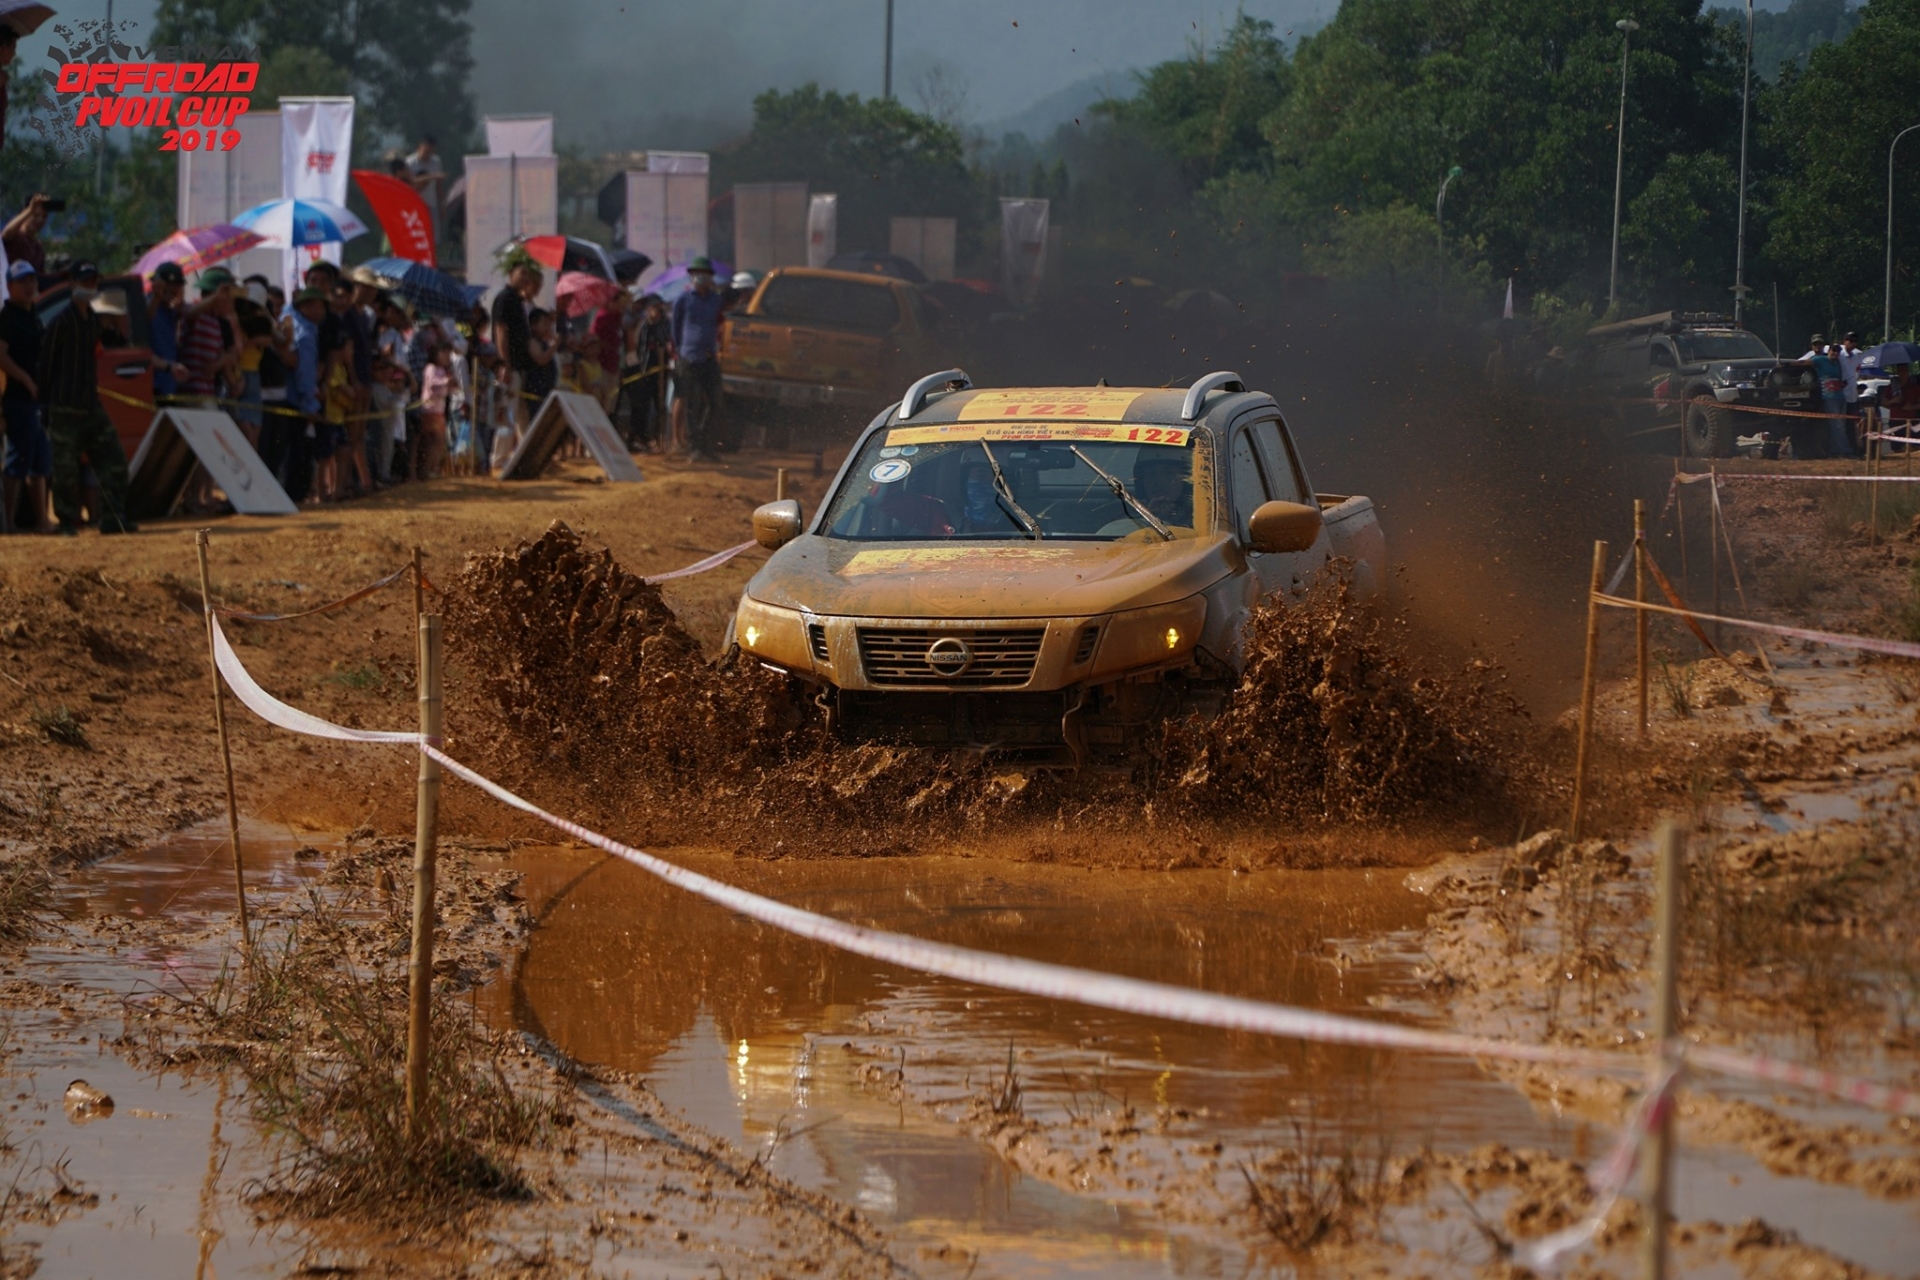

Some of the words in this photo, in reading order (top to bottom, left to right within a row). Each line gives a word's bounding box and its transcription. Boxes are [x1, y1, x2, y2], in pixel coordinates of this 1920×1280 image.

[1003, 404, 1088, 416] 122
[1127, 428, 1184, 444] 122
[883, 465, 900, 477] 7
[930, 654, 968, 662] NISSAN
